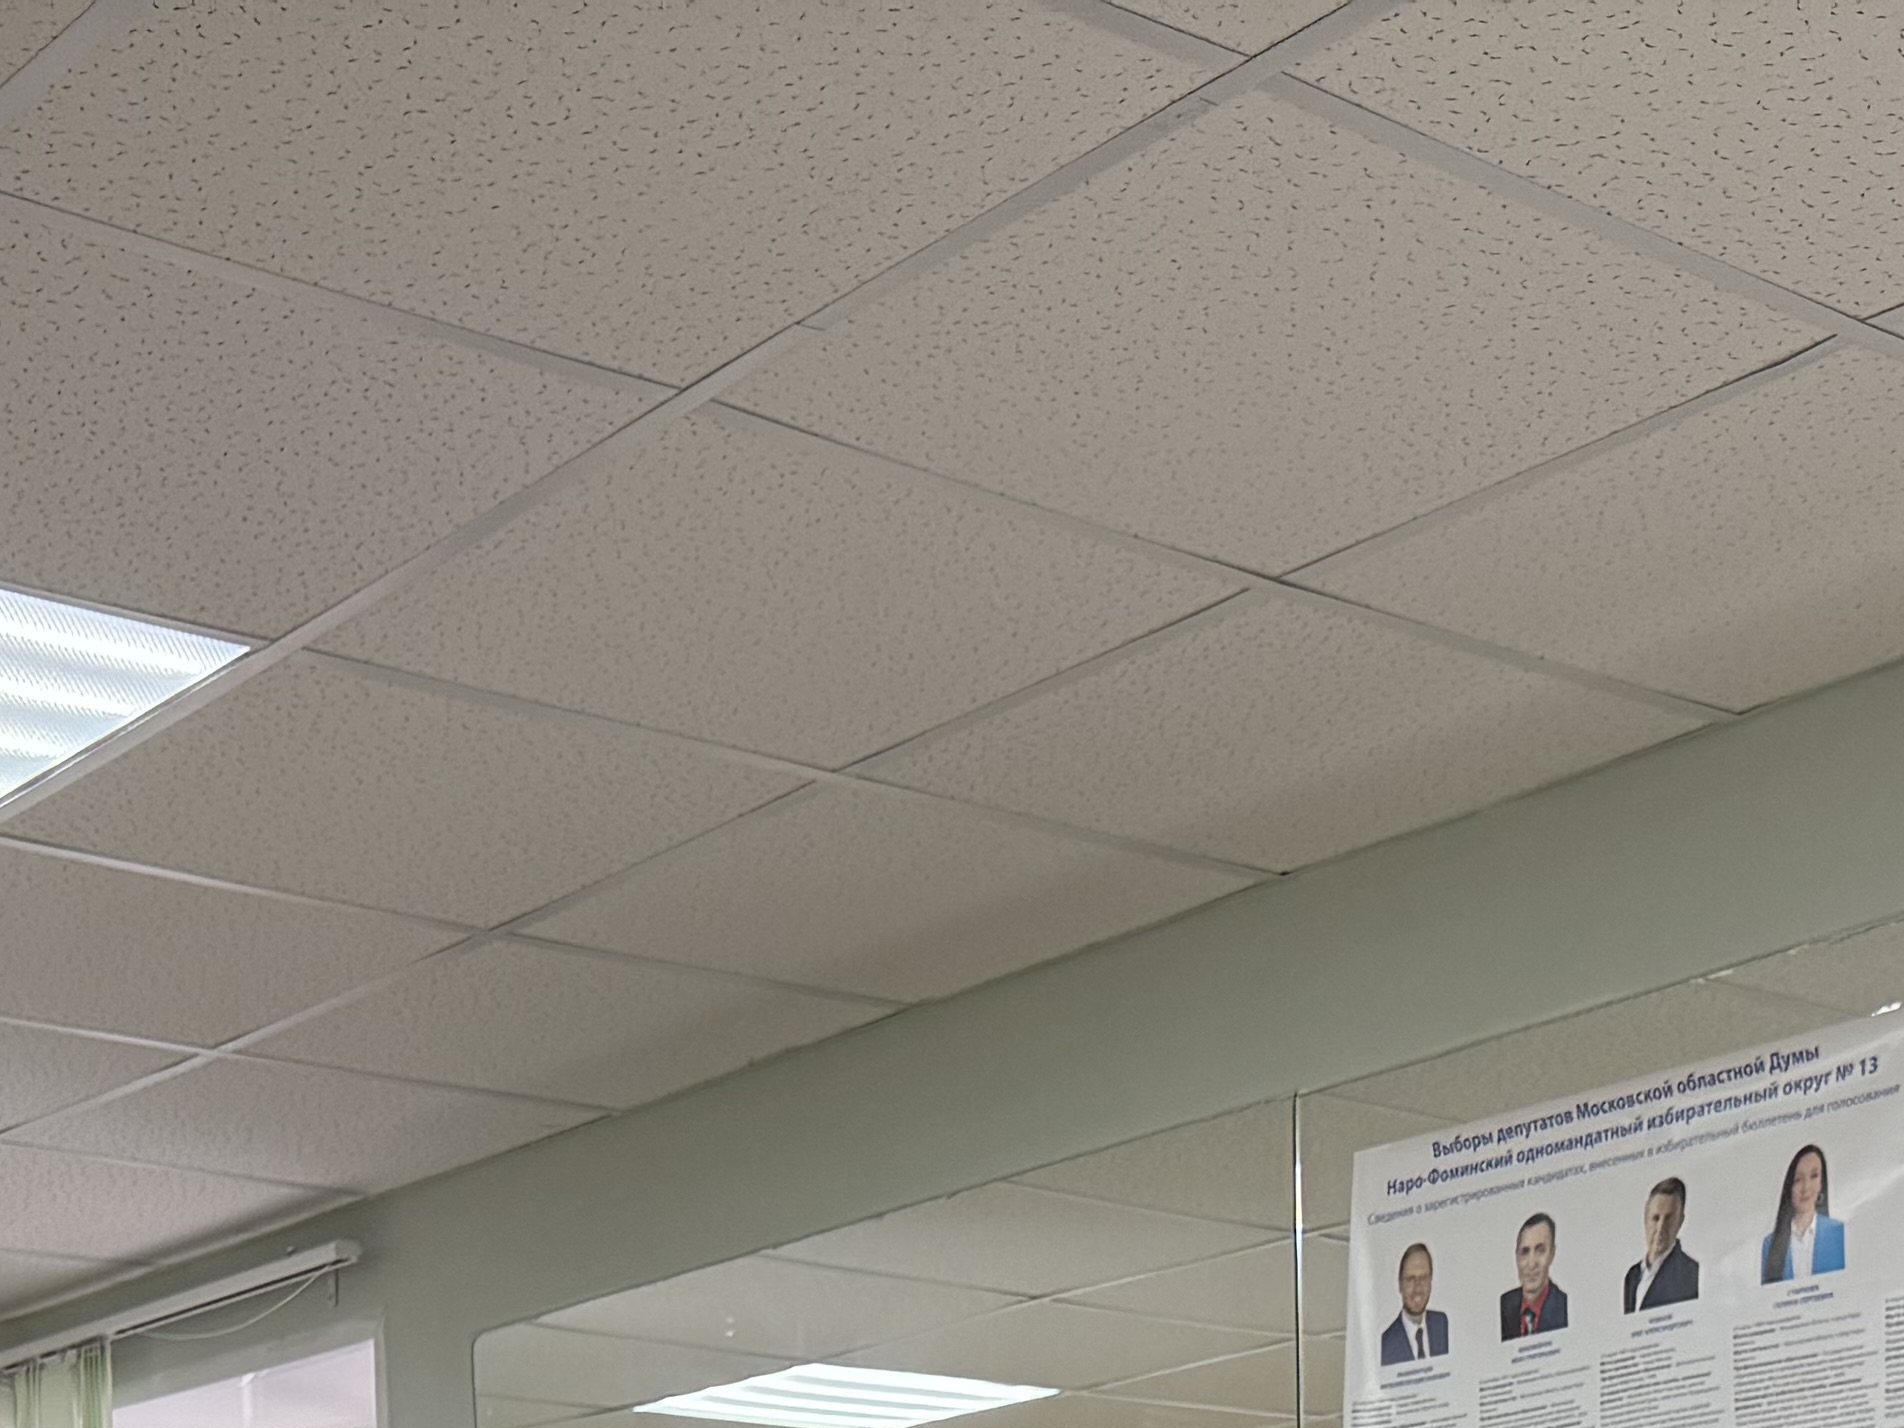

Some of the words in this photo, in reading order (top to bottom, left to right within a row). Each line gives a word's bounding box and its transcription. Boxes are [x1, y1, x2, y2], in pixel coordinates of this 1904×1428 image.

[1386, 1148, 1514, 1196] Наро-Фоминский
[1515, 1114, 1644, 1165] одномандатный
[1646, 1080, 1779, 1131] избирательный
[1781, 1069, 1833, 1096] округ
[1835, 1061, 1855, 1083] №
[1858, 1054, 1879, 1077] 13
[1431, 1131, 1494, 1159] Выборы
[1496, 1110, 1574, 1146] депутатов
[1575, 1078, 1674, 1121] Московской
[1676, 1055, 1766, 1095] областной
[1768, 1045, 1820, 1076] Думы
